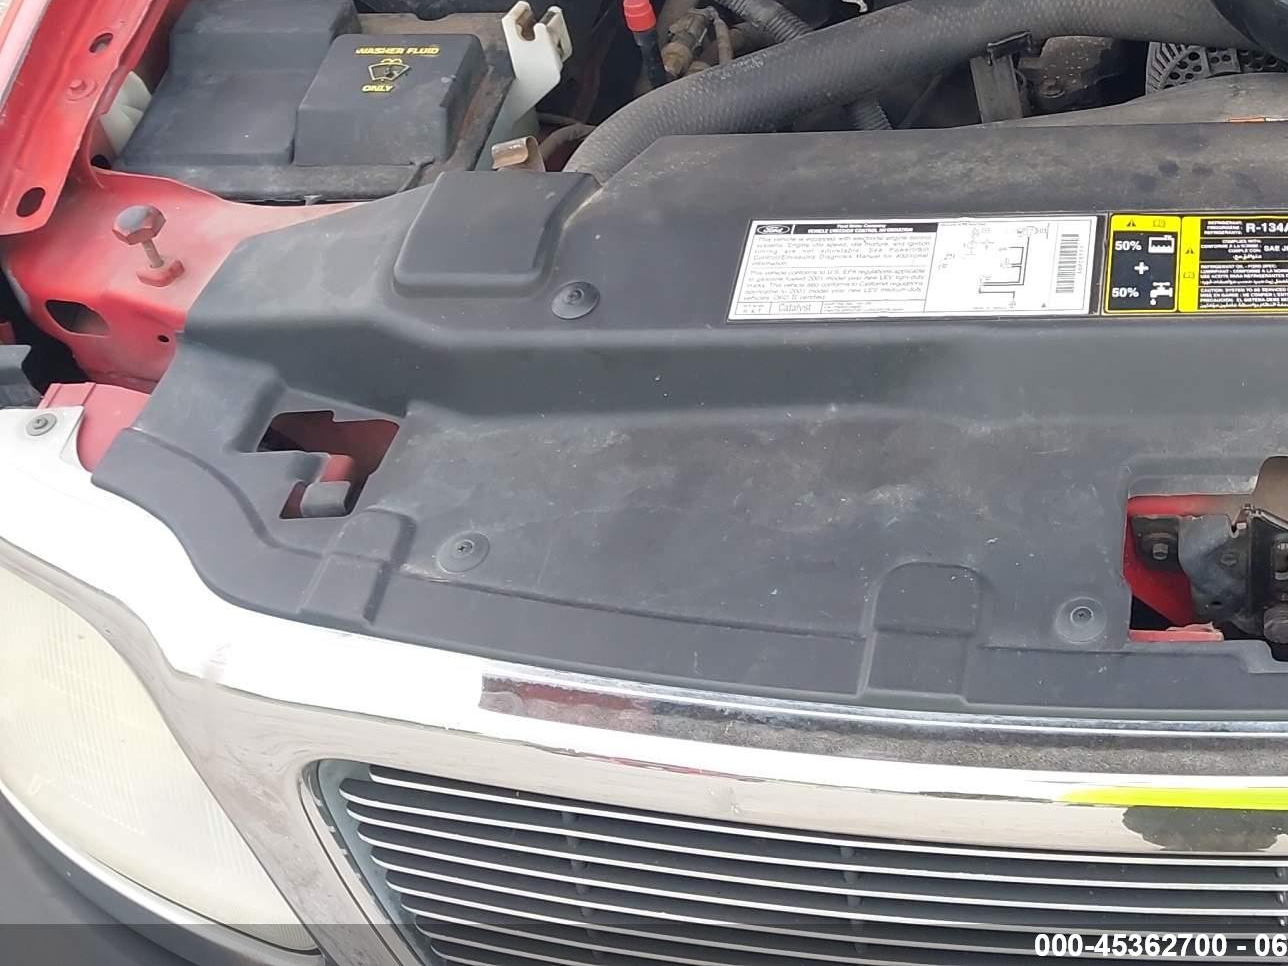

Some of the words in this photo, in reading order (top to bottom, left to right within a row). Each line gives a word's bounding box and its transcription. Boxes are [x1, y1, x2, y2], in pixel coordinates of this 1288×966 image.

[406, 46, 440, 54] FLUID
[1115, 240, 1142, 251] 50%
[1112, 287, 1140, 298] 50%
